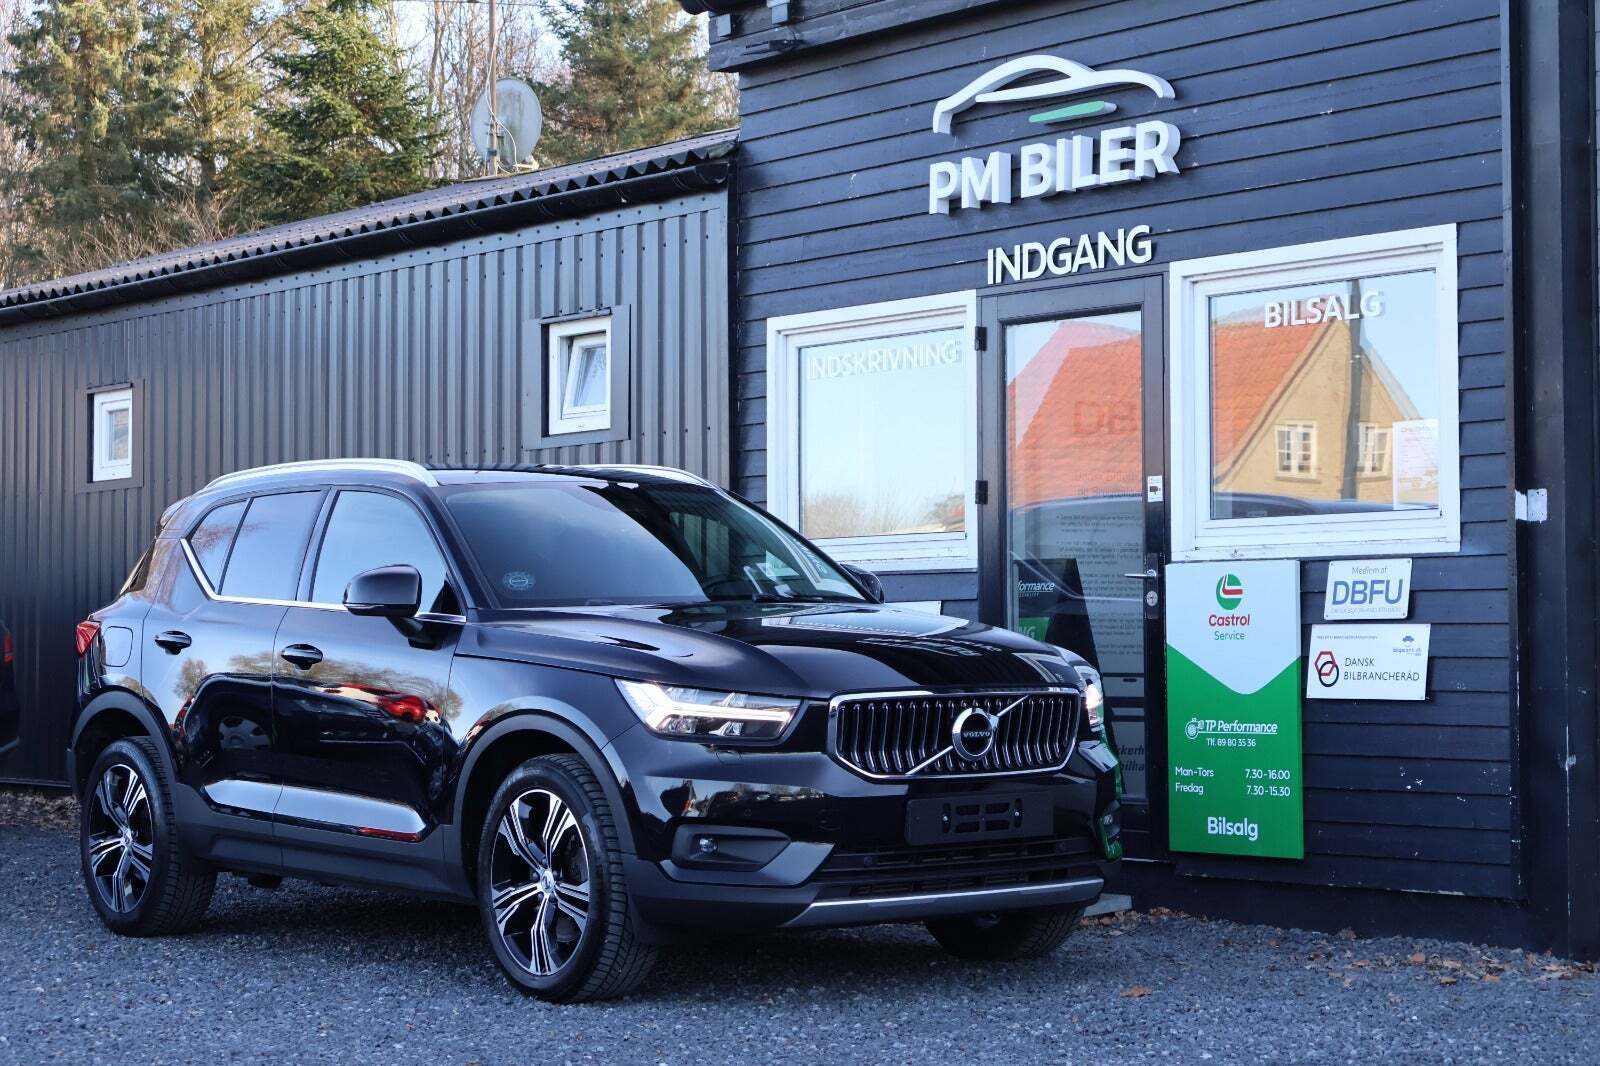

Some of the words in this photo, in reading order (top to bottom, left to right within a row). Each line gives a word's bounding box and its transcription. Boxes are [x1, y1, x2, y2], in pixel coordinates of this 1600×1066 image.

[929, 150, 1012, 214] PM
[1021, 120, 1181, 198] BILER
[987, 225, 1152, 285] INDGANG
[1264, 288, 1384, 328] BILSALG
[806, 339, 959, 380] INDSKRIVNING
[1332, 579, 1403, 605] DBFU
[1208, 613, 1250, 627] Castrol
[1214, 631, 1245, 641] Service
[1344, 657, 1375, 667] DANSK
[1343, 669, 1420, 681] BILBRANCHERÅD
[1205, 720, 1217, 732] TP
[1218, 720, 1278, 733] Performance
[1238, 738, 1247, 747] 35
[1247, 738, 1257, 747] 36
[1175, 782, 1204, 796] Fredag
[1207, 816, 1259, 841] Bilsalg
